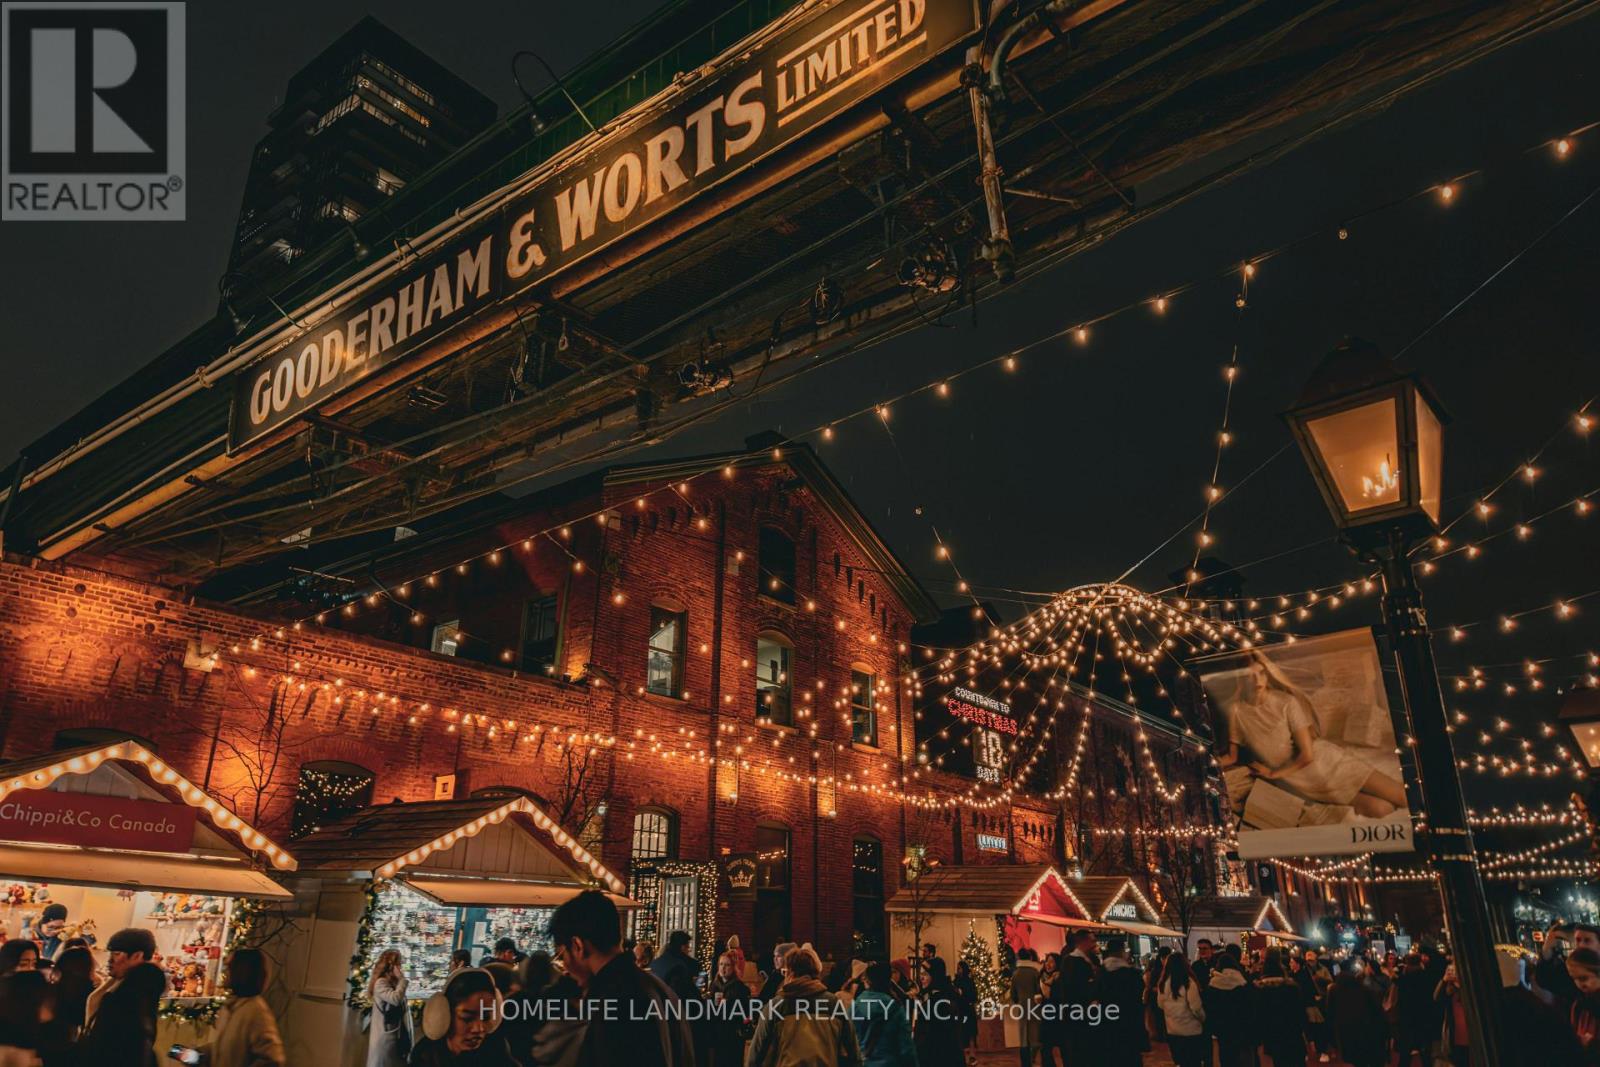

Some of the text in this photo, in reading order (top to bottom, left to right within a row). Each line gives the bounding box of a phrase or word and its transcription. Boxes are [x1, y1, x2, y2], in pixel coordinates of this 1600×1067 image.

[776, 0, 926, 112] LIMITED
[249, 70, 766, 425] GOODERHAM & WORTS
[976, 765, 1000, 783] DAYS
[0, 803, 176, 834] Chippi&Co Canada
[1351, 824, 1406, 843] DIOR
